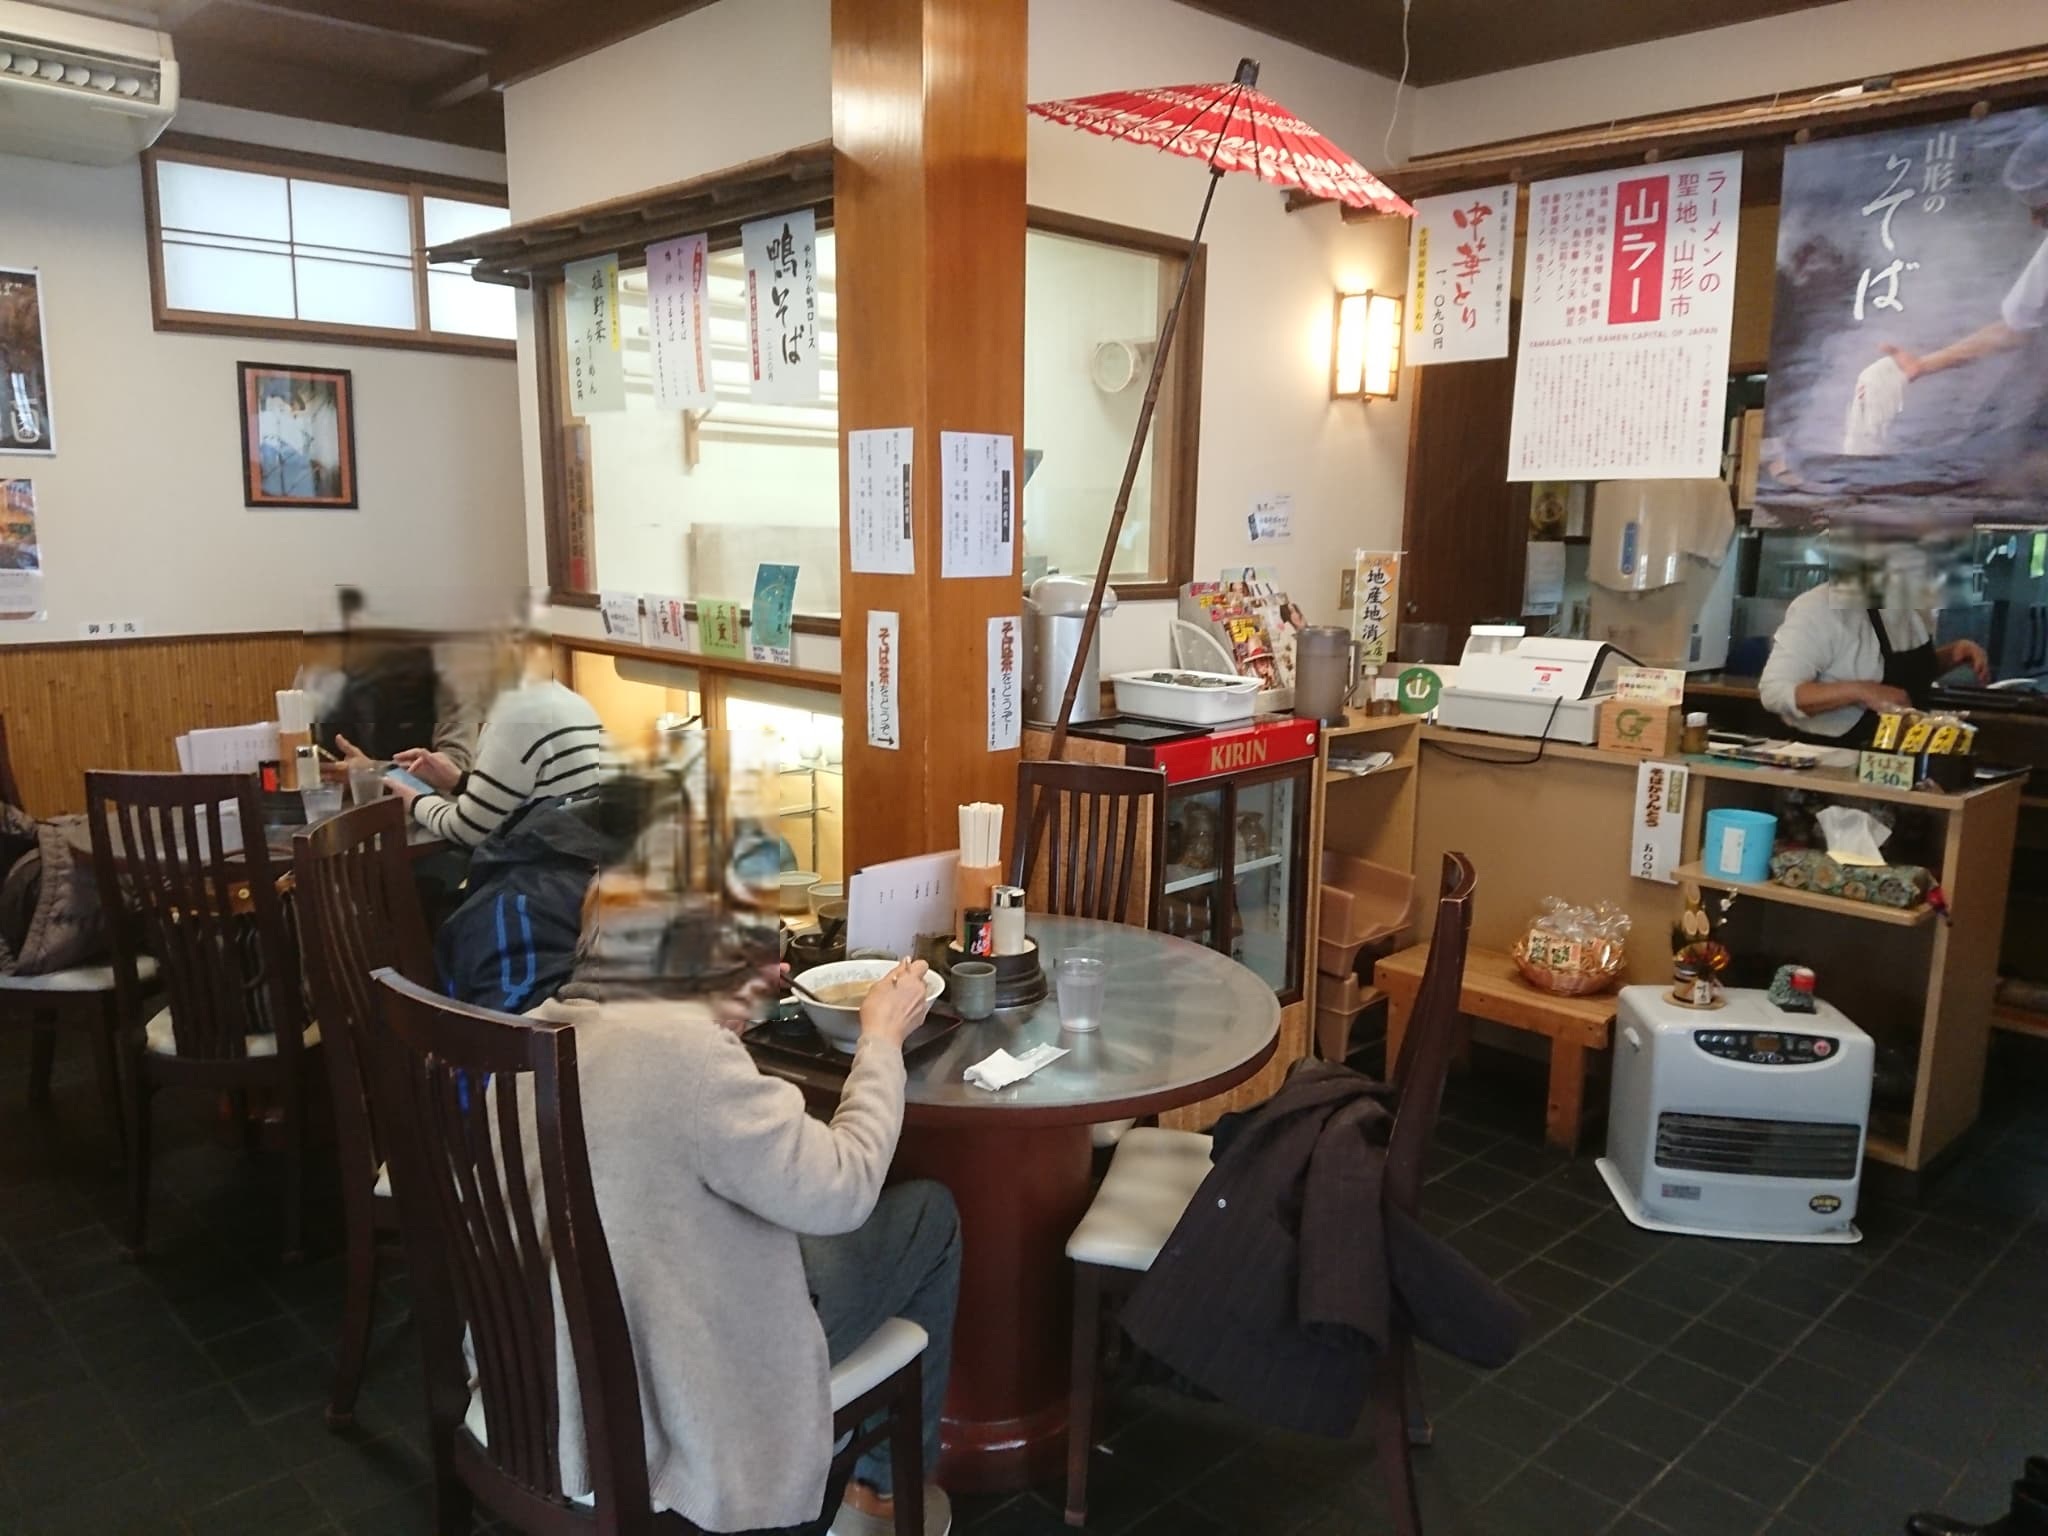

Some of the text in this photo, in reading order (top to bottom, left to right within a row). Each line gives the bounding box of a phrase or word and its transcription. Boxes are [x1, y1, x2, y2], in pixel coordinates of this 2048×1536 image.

[1699, 170, 1726, 292] ラーメンの
[1853, 153, 1921, 320] そば
[1922, 131, 1957, 214] 山形の
[766, 221, 805, 366] 鴨そば
[1452, 201, 1493, 329] 中華とり
[1622, 187, 1660, 315] 山ラー
[1670, 173, 1700, 318] 聖地、山形市
[1578, 336, 1594, 345] THE
[1597, 334, 1629, 343] RAMEN
[1632, 331, 1667, 341] CAPITAL
[1672, 329, 1683, 338] OF
[1688, 327, 1719, 337] JAPAN
[1210, 737, 1268, 772] KIRIN
